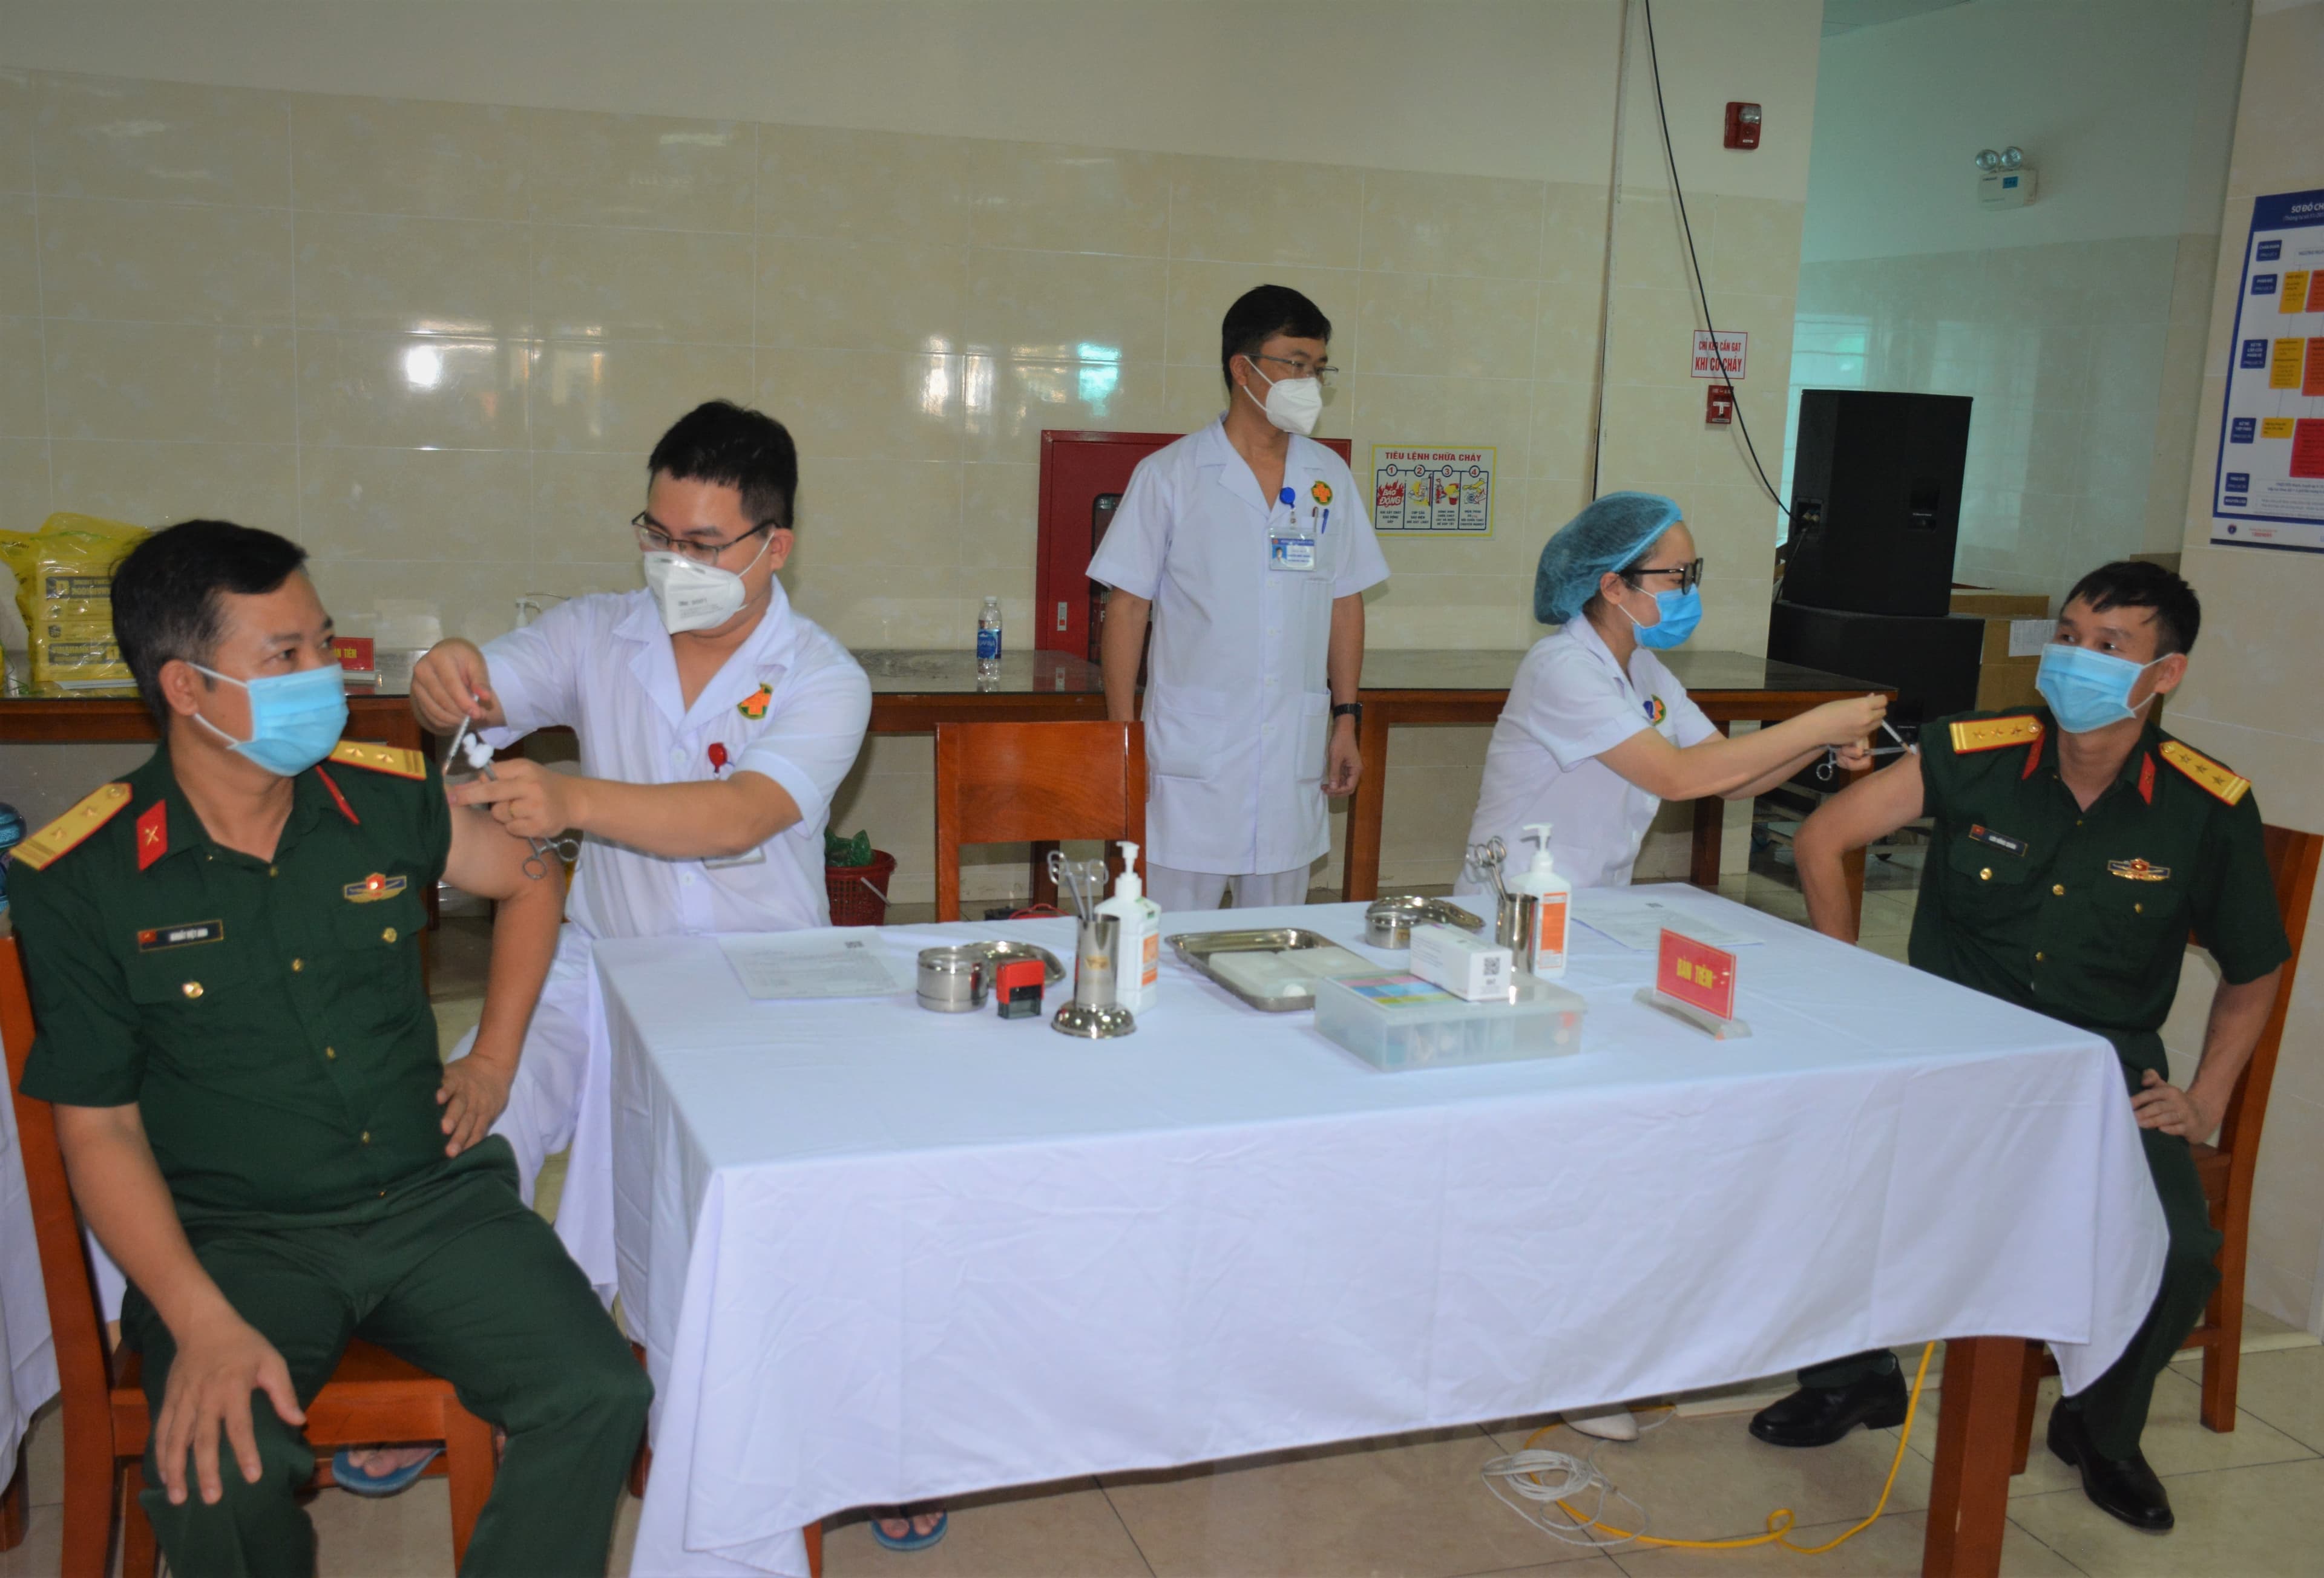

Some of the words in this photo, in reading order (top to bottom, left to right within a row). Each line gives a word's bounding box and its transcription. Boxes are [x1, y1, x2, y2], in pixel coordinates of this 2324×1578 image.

[1695, 357, 1708, 370] KHI
[1407, 453, 1430, 462] LỆNH
[1433, 451, 1456, 460] CHỮA
[1459, 453, 1481, 462] CHÁY
